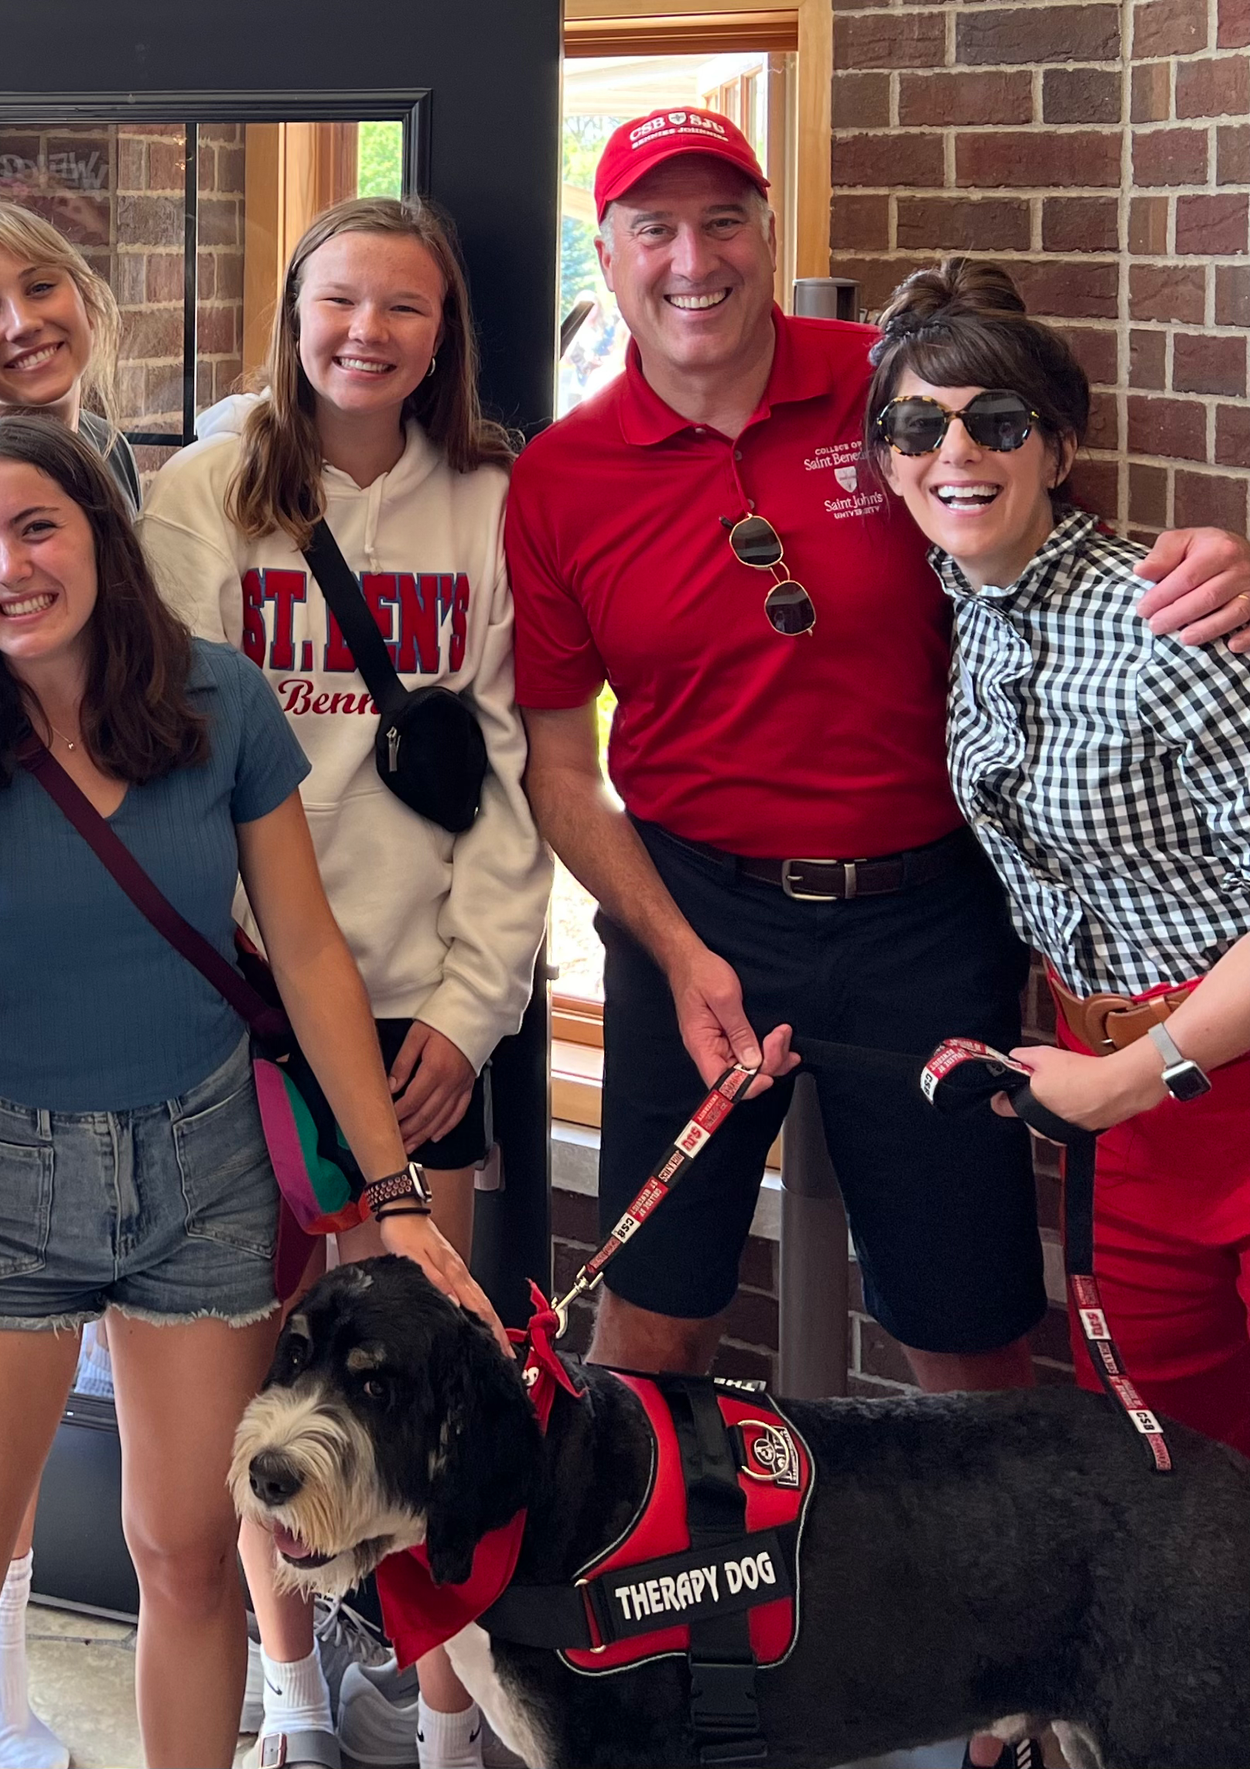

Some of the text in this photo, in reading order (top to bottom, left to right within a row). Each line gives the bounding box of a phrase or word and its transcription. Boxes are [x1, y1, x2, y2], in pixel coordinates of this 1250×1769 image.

[630, 114, 725, 141] CSB SJU
[815, 443, 849, 455] COLLEGE
[804, 456, 832, 471] Saint
[824, 491, 883, 512] Saint John's
[242, 568, 313, 672] ST.
[681, 1125, 702, 1151] SJU
[617, 1218, 635, 1238] CSB
[1086, 1312, 1104, 1337] SJU
[1136, 1411, 1155, 1430] CSB
[615, 1551, 776, 1621] THERAPY DOG
